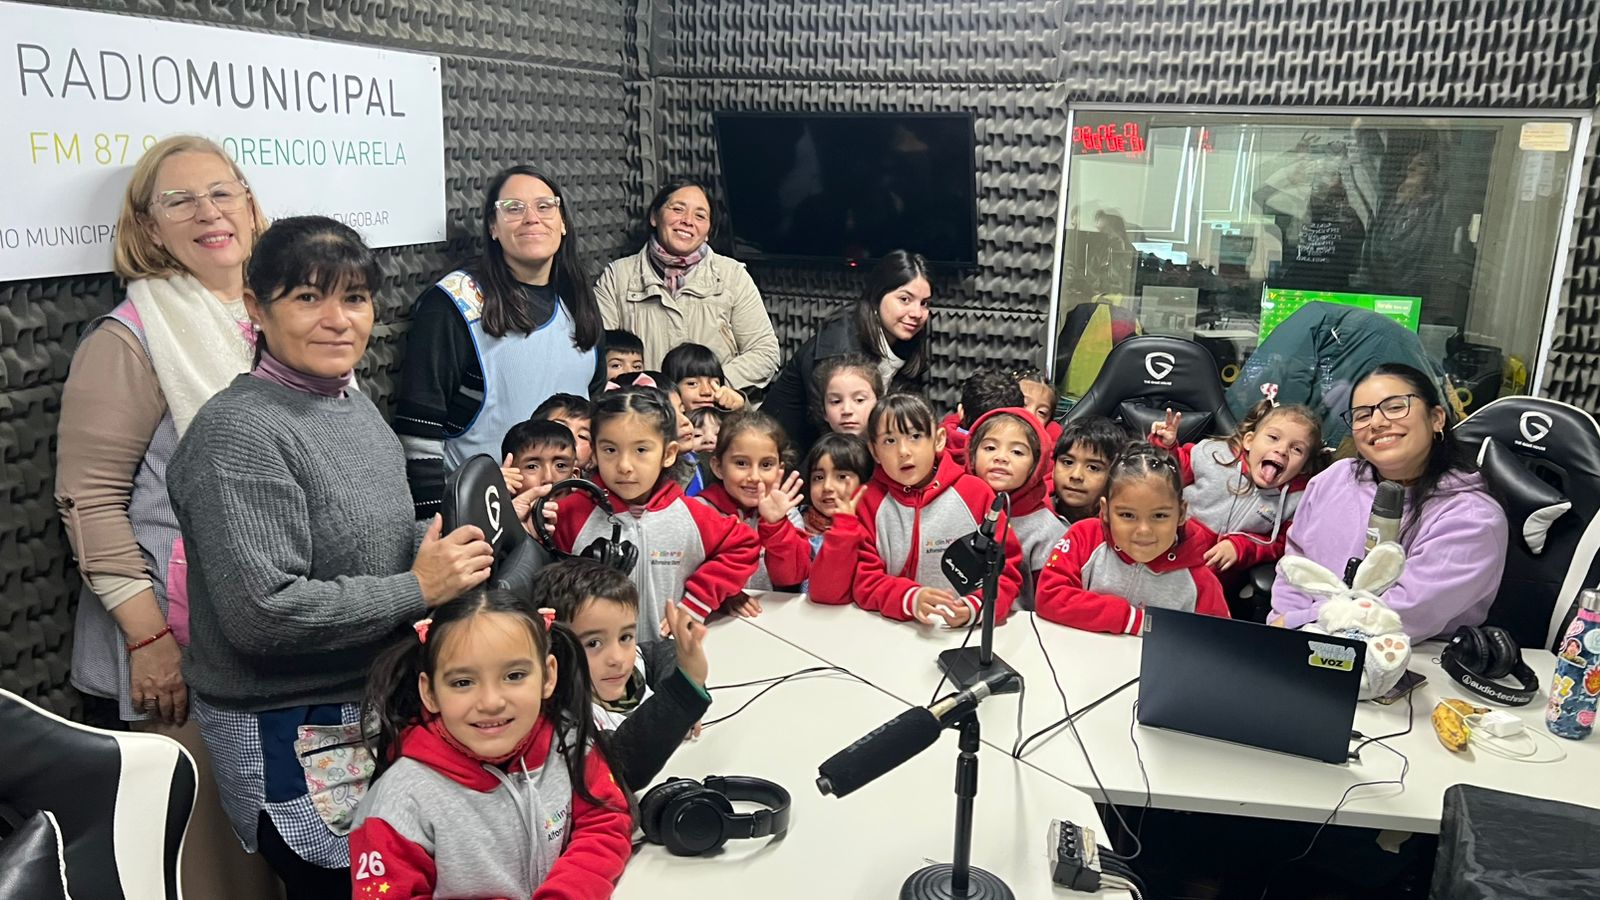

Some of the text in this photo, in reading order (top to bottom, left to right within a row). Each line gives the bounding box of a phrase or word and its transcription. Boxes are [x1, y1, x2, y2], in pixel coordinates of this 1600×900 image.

[29, 131, 81, 165] FM
[223, 136, 327, 167] ORENCIO
[331, 140, 407, 166] VARELA
[1319, 657, 1344, 668] VOZ
[356, 850, 386, 880] 26
